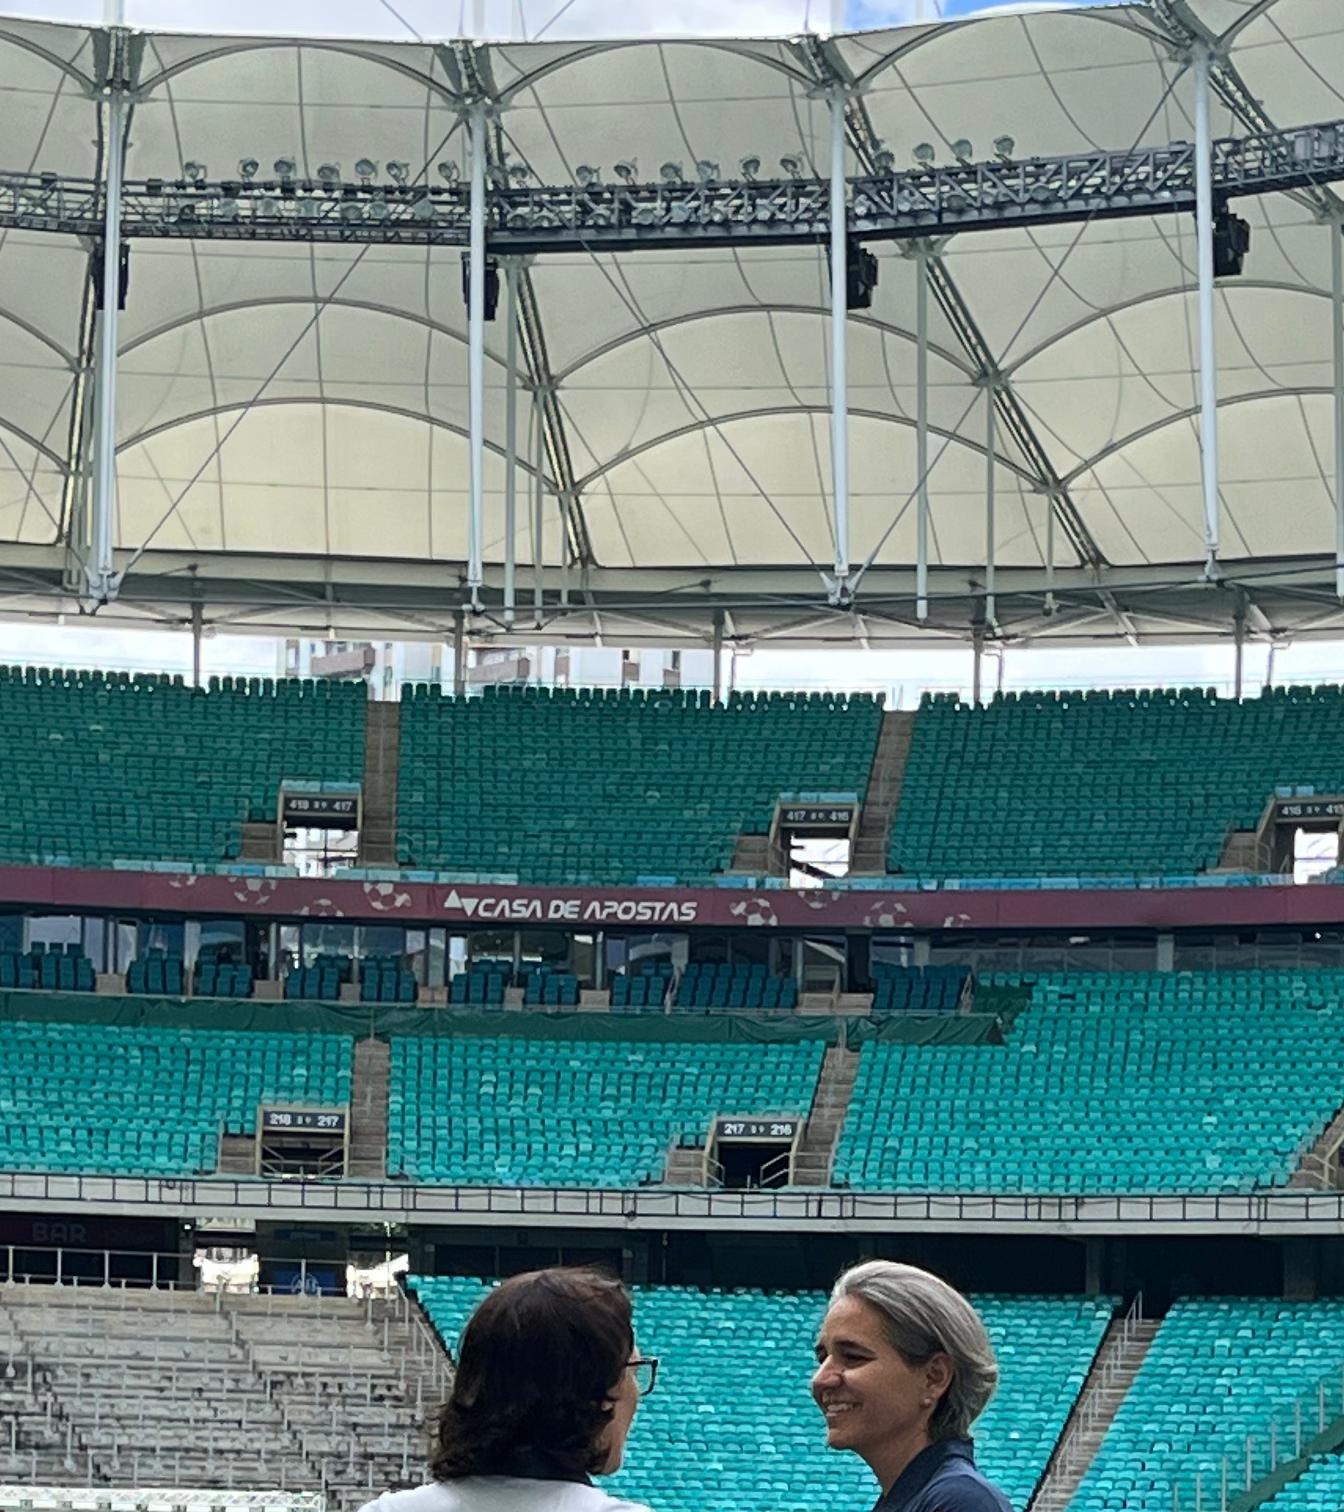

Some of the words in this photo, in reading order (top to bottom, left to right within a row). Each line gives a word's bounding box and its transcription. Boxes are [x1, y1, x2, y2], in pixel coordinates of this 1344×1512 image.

[333, 800, 353, 811] 417
[787, 810, 806, 821] 417
[478, 898, 542, 918] CASA
[548, 899, 581, 919] DE
[584, 901, 698, 921] APOSTAS
[269, 1113, 292, 1125] 218
[317, 1115, 339, 1127] 217
[723, 1122, 745, 1135] 217
[770, 1123, 792, 1135] 216
[31, 1220, 87, 1242] BAR
